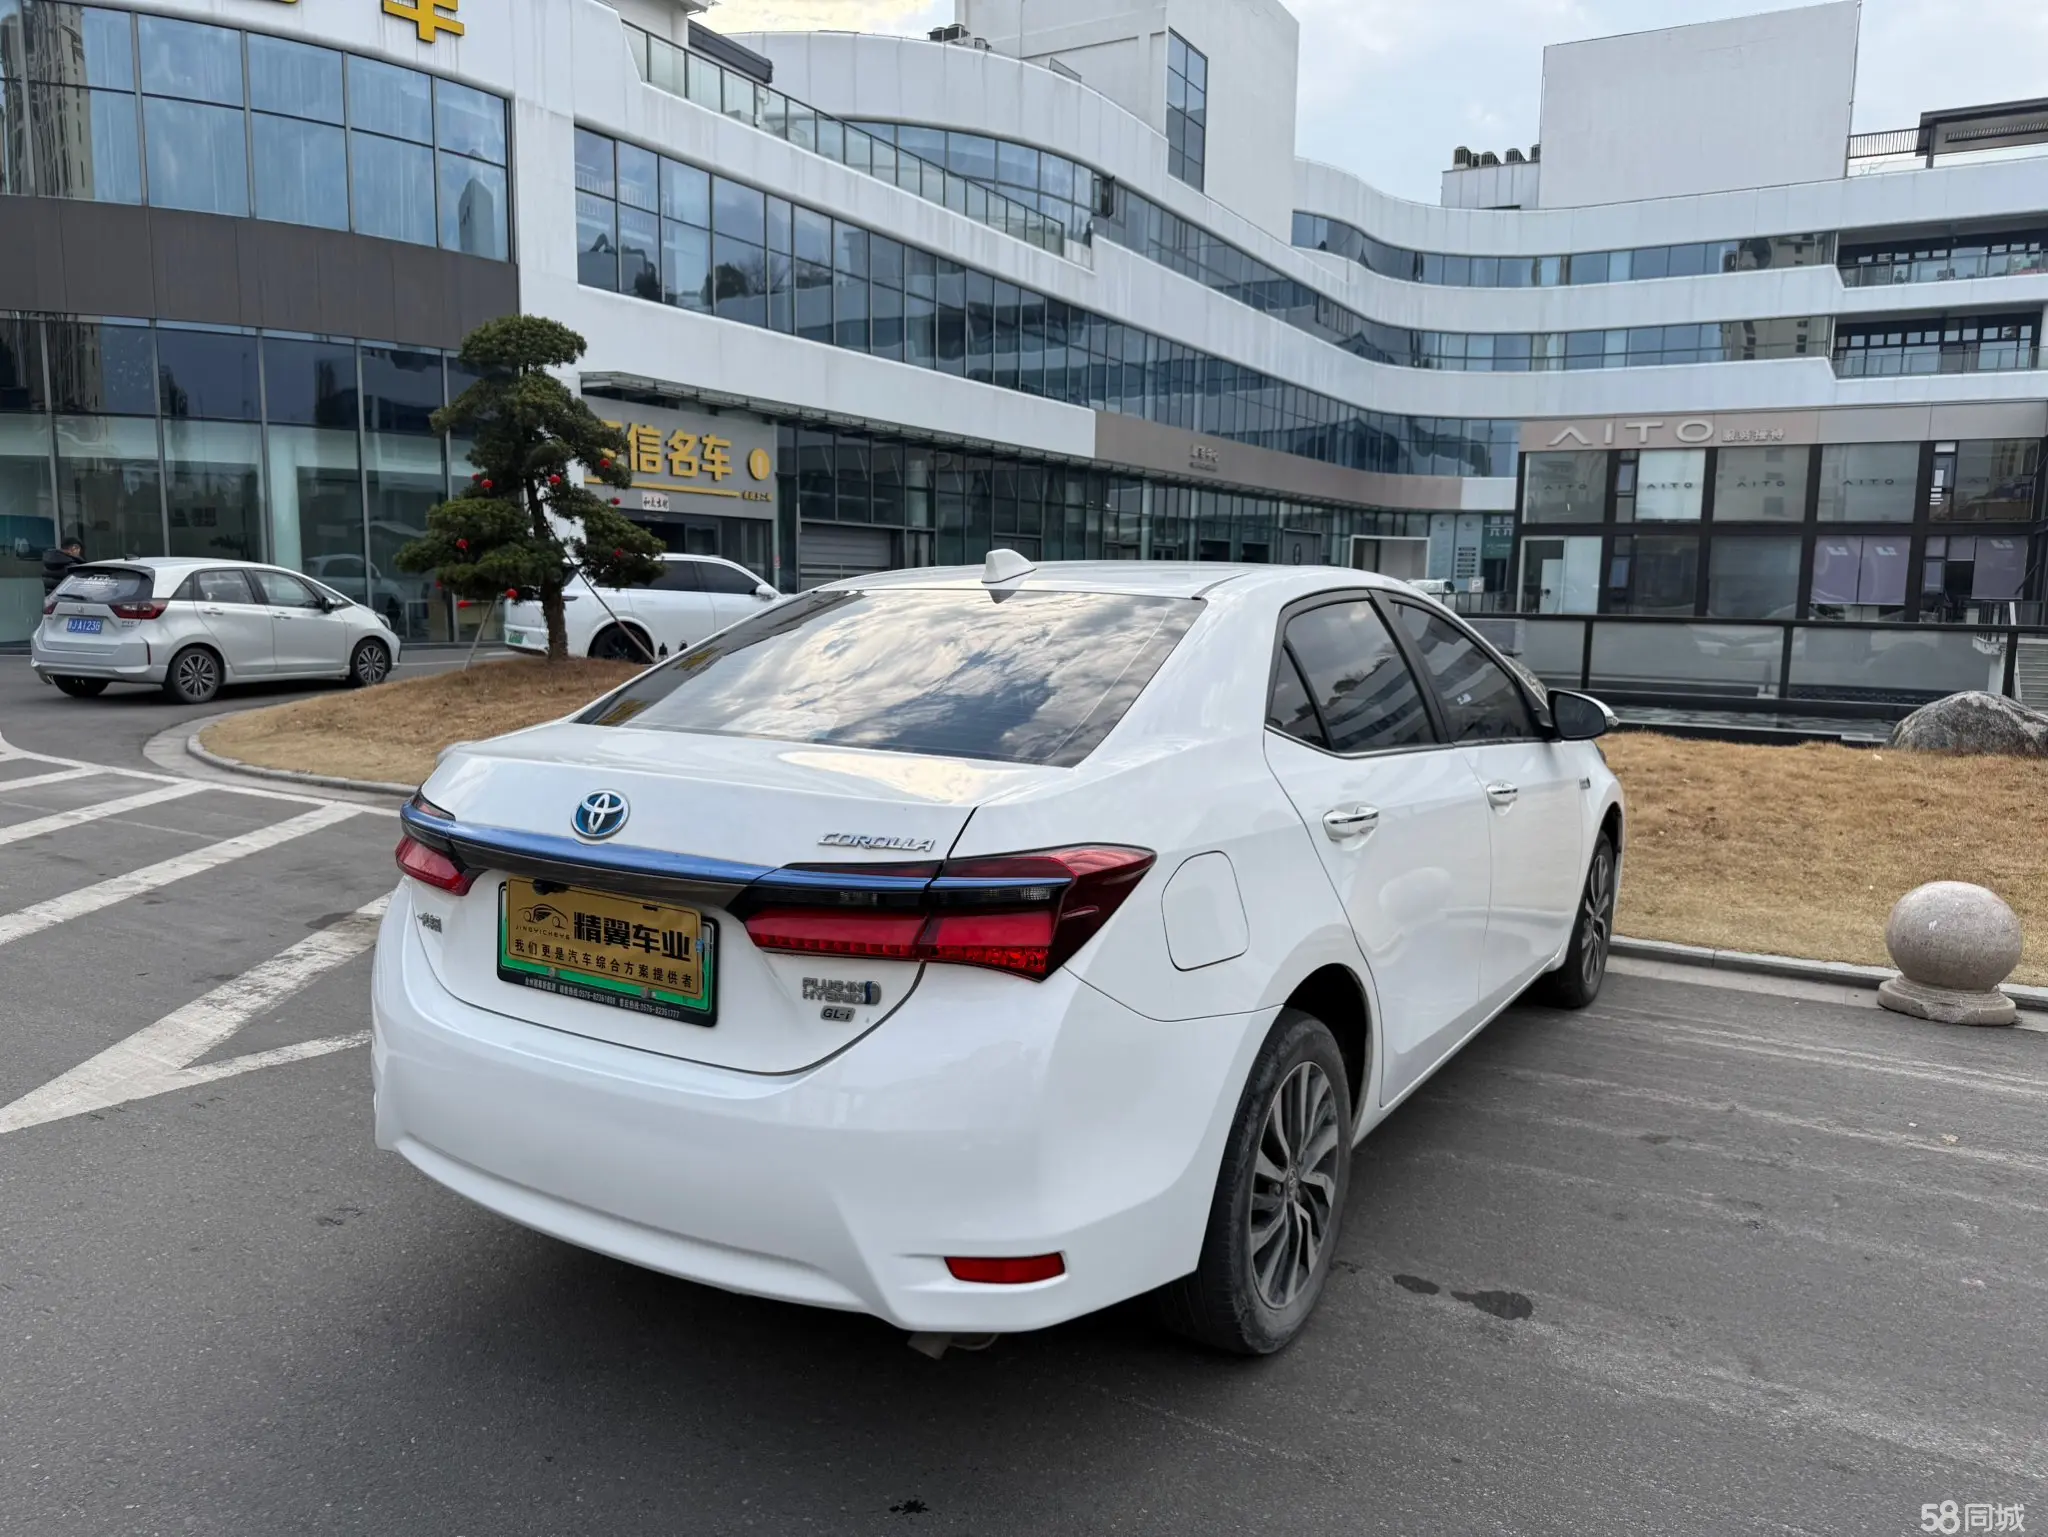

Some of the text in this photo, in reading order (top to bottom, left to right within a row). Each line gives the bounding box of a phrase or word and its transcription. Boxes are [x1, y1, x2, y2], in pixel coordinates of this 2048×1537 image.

[1547, 419, 1714, 446] AITO
[1647, 482, 1693, 490] AITO
[818, 833, 935, 852] COROLLA
[573, 911, 691, 962] 精翼车业
[514, 938, 693, 988] 我们更是汽车综合方案提供者
[802, 977, 865, 993] PLUG-IN
[823, 1008, 851, 1020] GL-i
